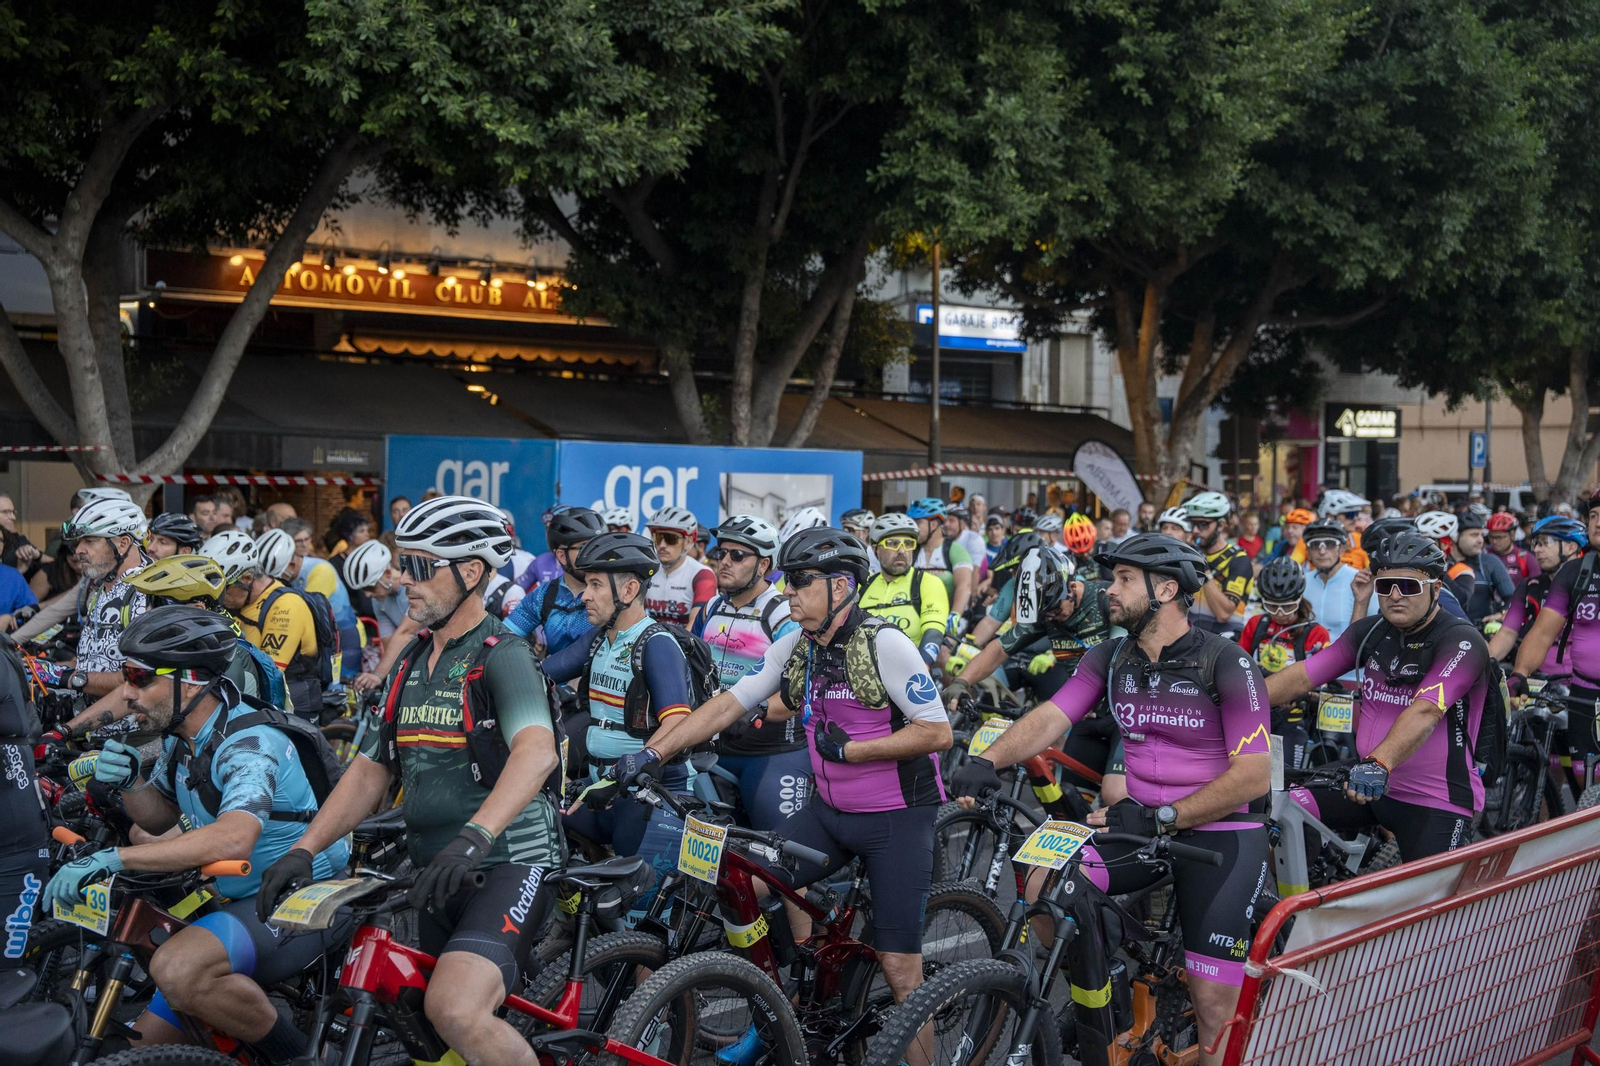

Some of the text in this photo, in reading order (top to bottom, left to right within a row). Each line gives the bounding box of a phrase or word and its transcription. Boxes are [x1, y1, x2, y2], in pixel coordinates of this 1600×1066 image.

[239, 264, 562, 311] ATOMOVIL CLUB AL
[945, 313, 986, 328] GARAJE
[1474, 436, 1484, 463] P
[470, 542, 487, 551] ABUS
[818, 549, 839, 561] BELL
[718, 661, 745, 671] ELECTRO
[1169, 687, 1199, 695] albaida
[1246, 670, 1261, 712] Espabrok
[1140, 704, 1202, 716] FUNDACIÓN
[1322, 706, 1351, 720] 10099
[1138, 712, 1206, 728] primaflor
[687, 836, 719, 864] 10020
[1035, 833, 1079, 854] 10022
[1250, 860, 1268, 904] Espabrok
[509, 865, 545, 923] Occiden
[4, 873, 42, 958] wiber
[1209, 932, 1235, 948] MTB
[752, 993, 778, 1023] DT SWISS
